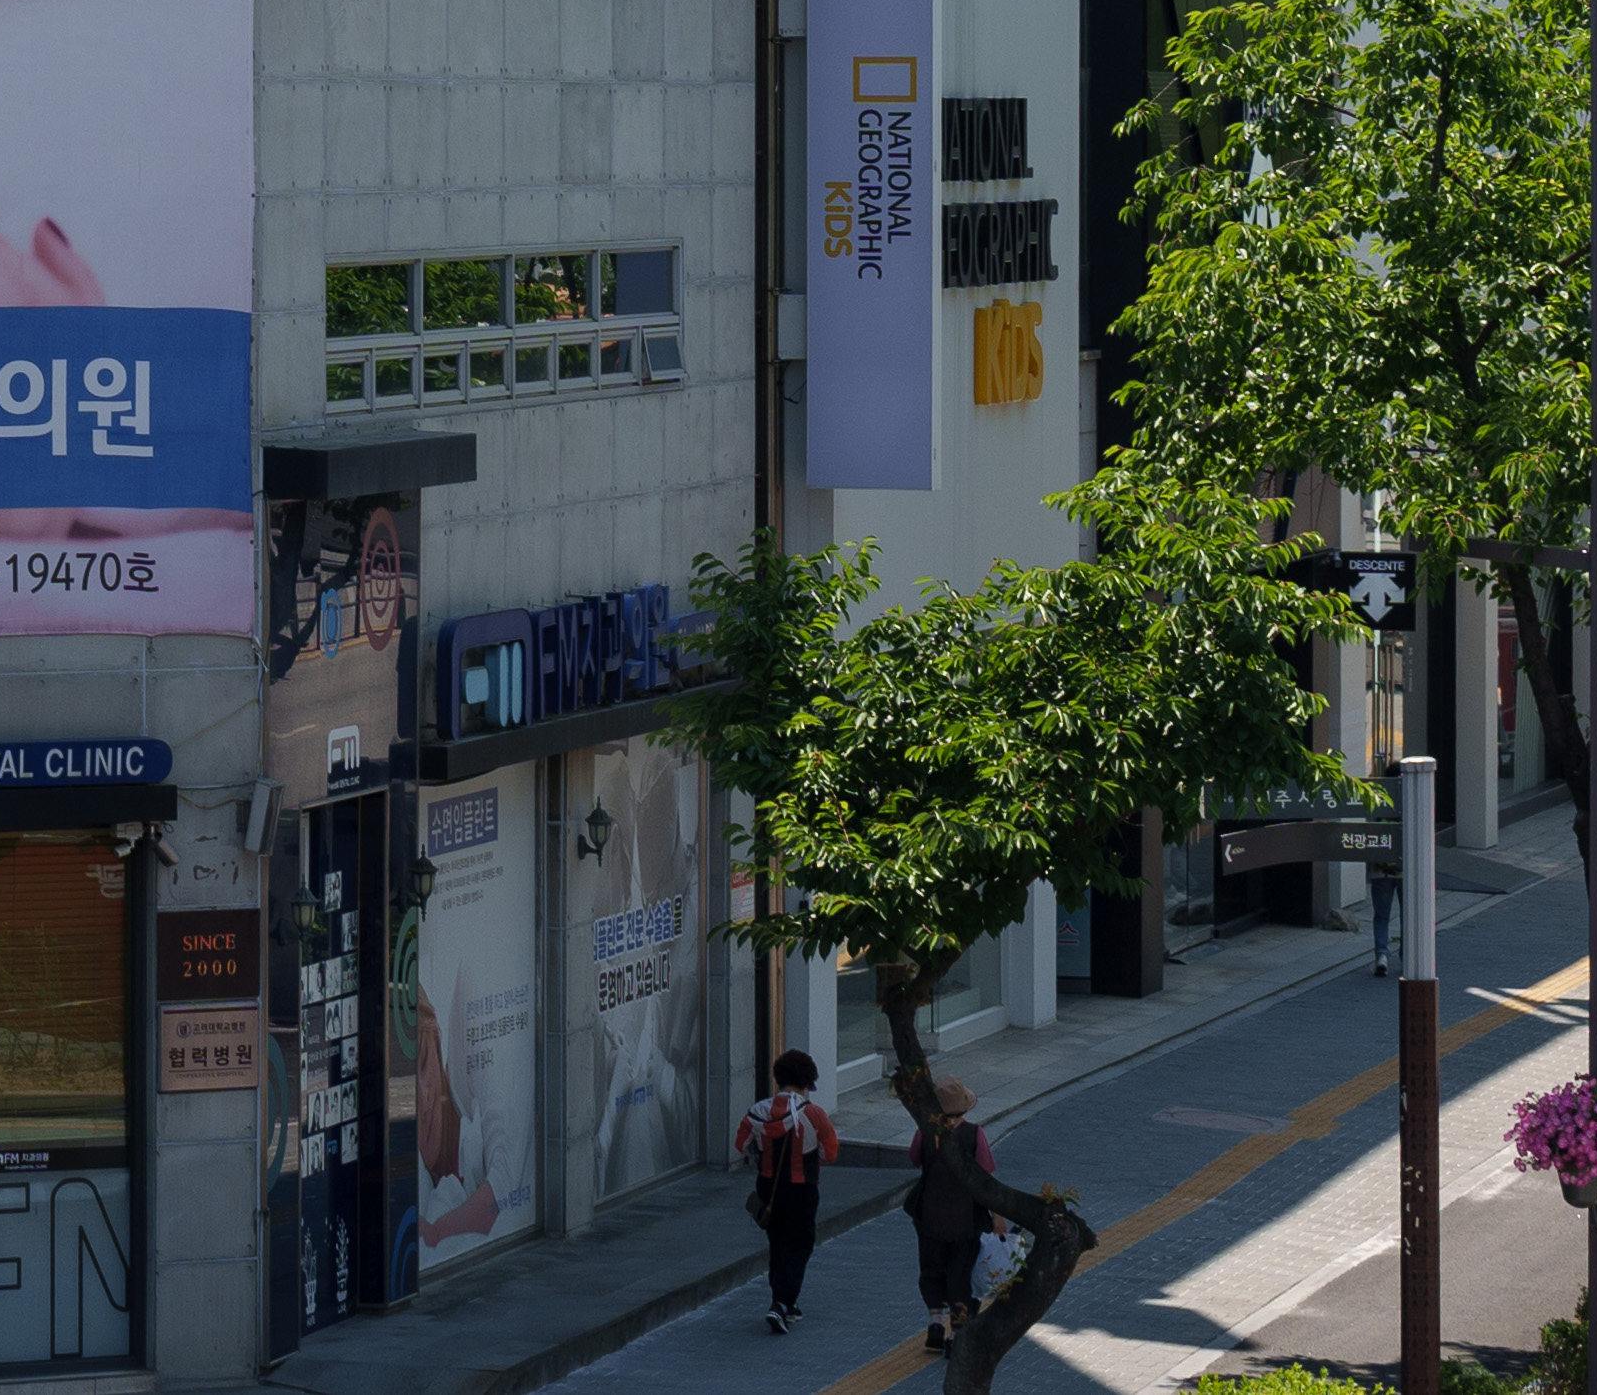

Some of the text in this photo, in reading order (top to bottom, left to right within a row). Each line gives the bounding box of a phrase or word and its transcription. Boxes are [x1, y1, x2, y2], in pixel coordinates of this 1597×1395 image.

[942, 97, 1034, 182] ATIONAL
[857, 109, 883, 281] GEOGRAPHIC
[888, 111, 913, 244] NATIONAL
[942, 198, 1059, 289] EOGRAPHIC
[1348, 559, 1406, 572] DESCENTE
[44, 746, 145, 779] CLINIC
[431, 797, 495, 850] 수면임플란트
[1341, 833, 1393, 850] 천광교회
[182, 933, 236, 953] SINCE
[626, 909, 644, 953] 전문
[183, 958, 238, 978] 2000
[599, 951, 670, 1012] 운영하고 있습니다
[168, 1044, 252, 1069] 협력병원
